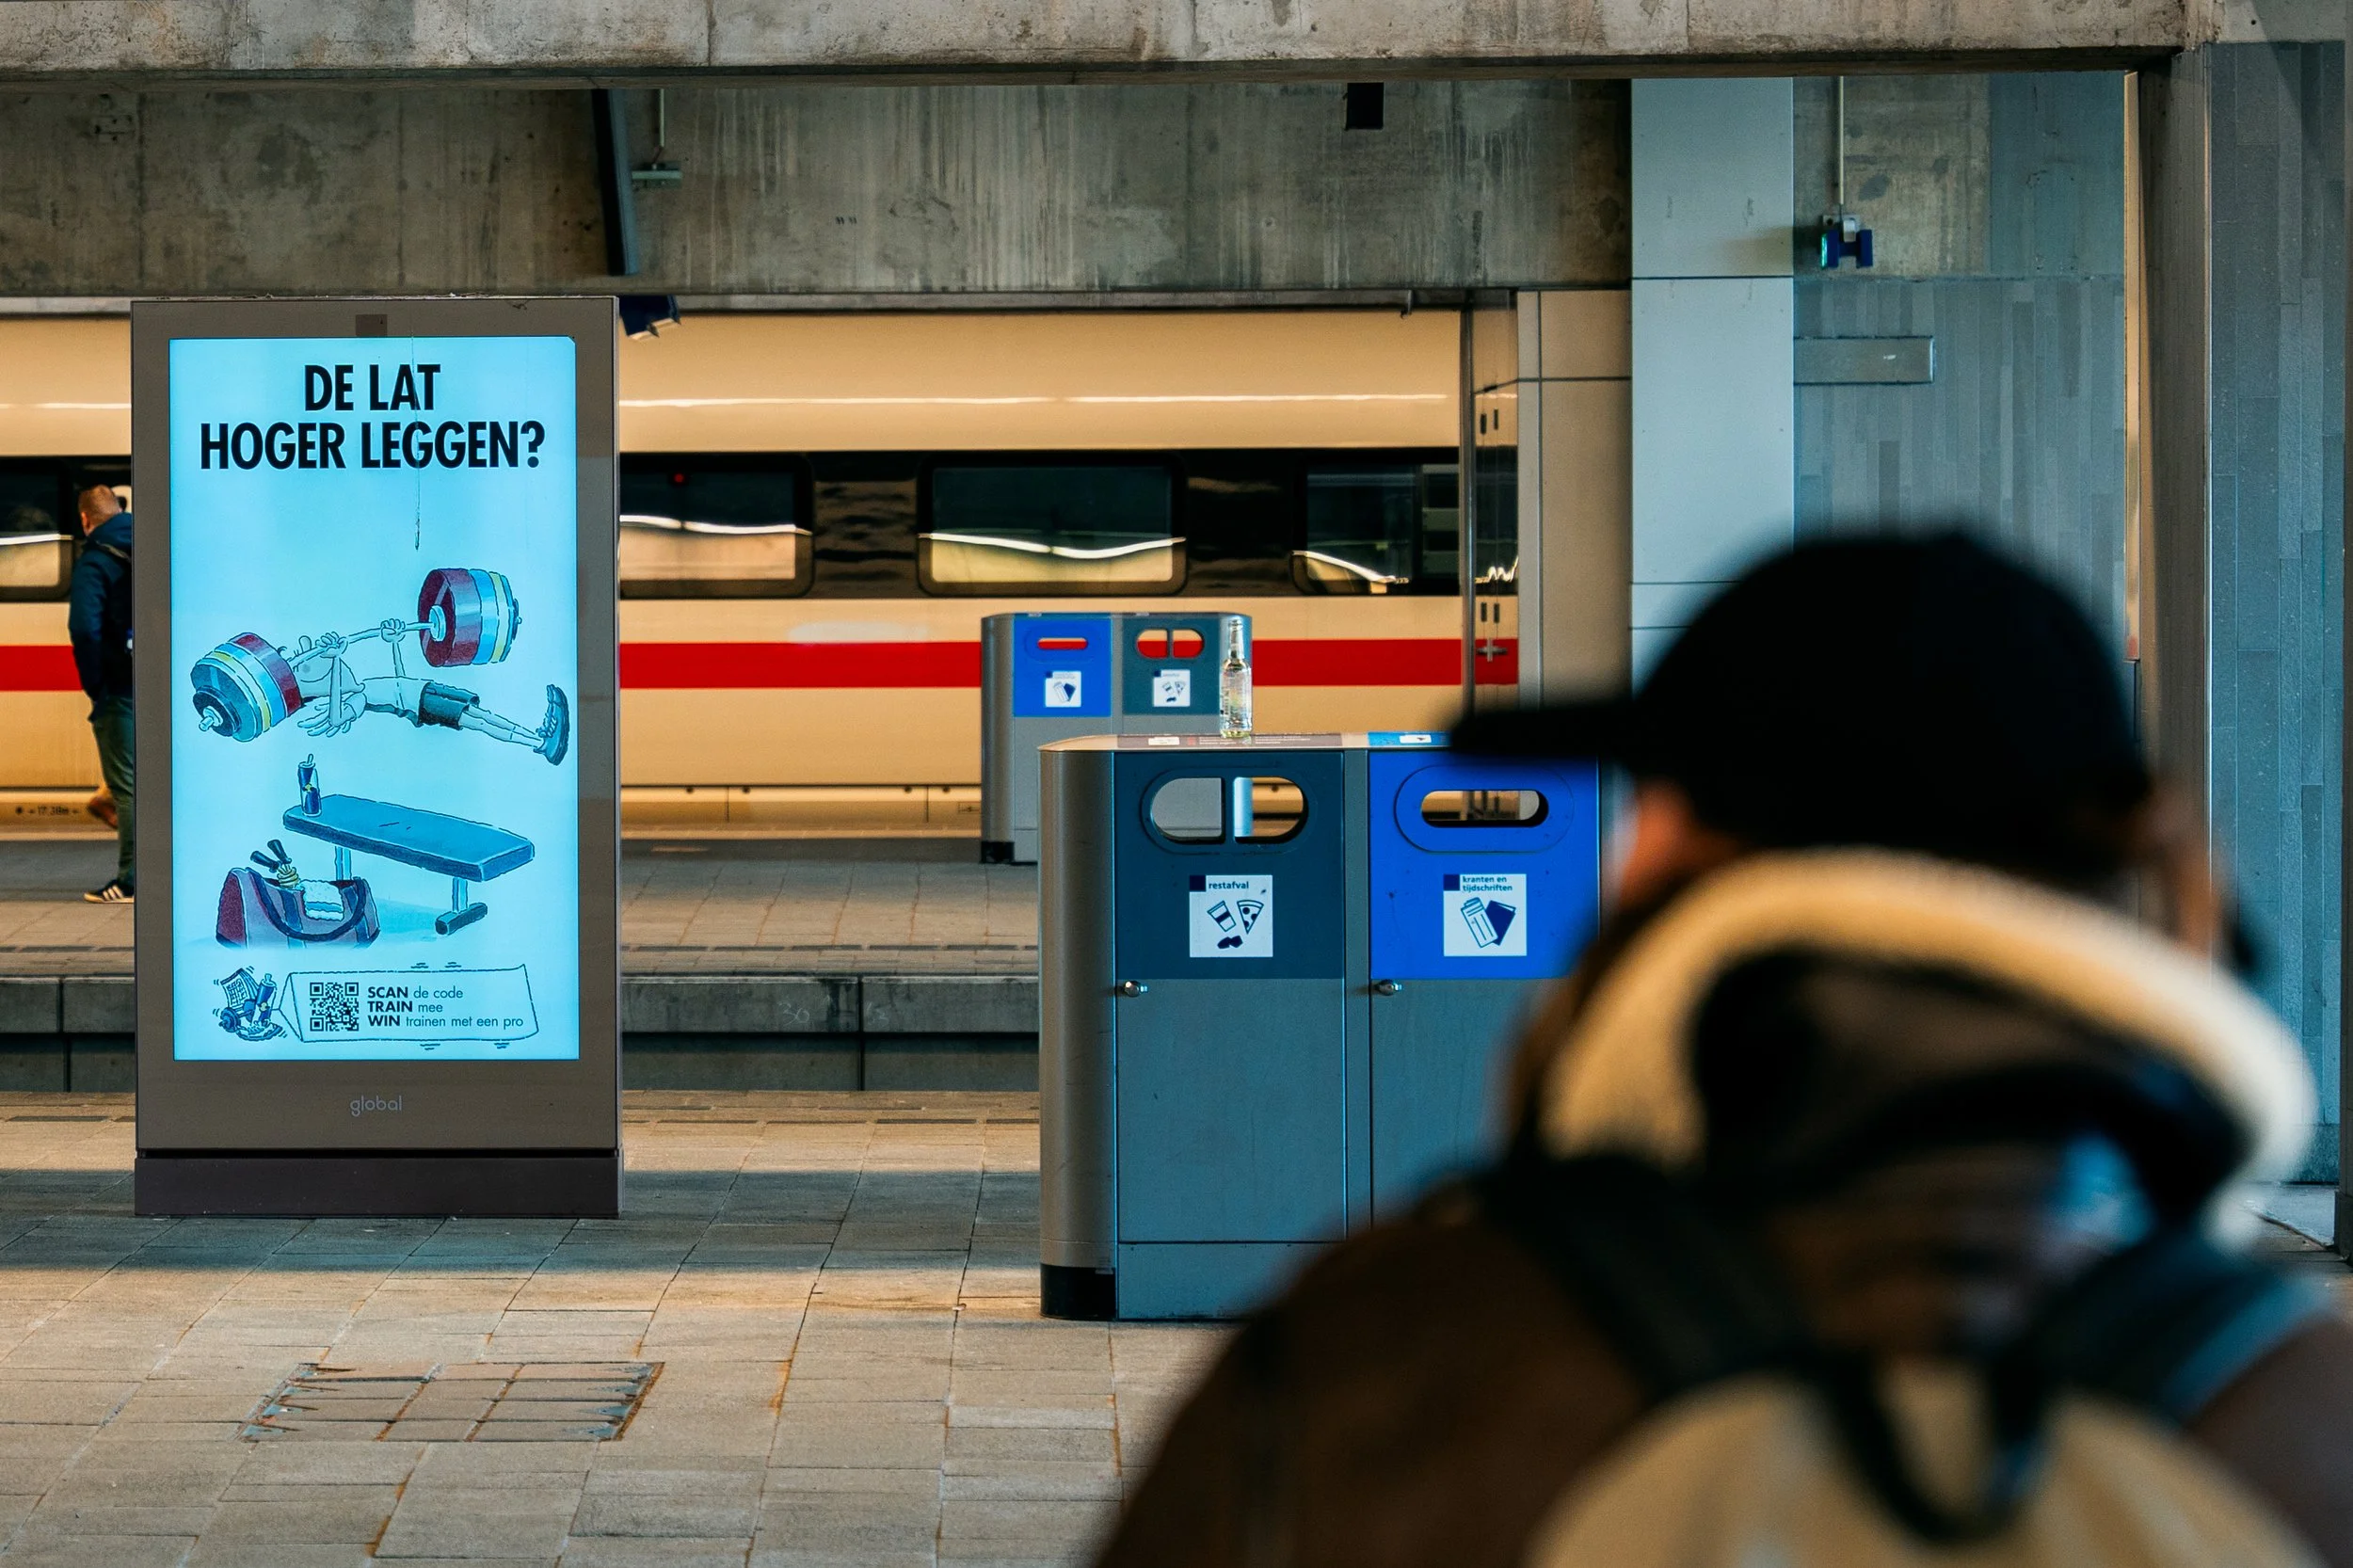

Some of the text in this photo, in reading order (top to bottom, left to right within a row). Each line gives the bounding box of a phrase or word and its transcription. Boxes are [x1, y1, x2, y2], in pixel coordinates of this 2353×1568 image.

[304, 363, 441, 411] DE LAT
[200, 420, 546, 470] HOGER LEGGEN?
[1209, 881, 1249, 889] restafval
[367, 985, 463, 999] SCAN de code
[367, 1000, 443, 1013] TRAIN mee
[367, 1015, 524, 1031] WIN trainen met een pro
[350, 1095, 403, 1117] global
